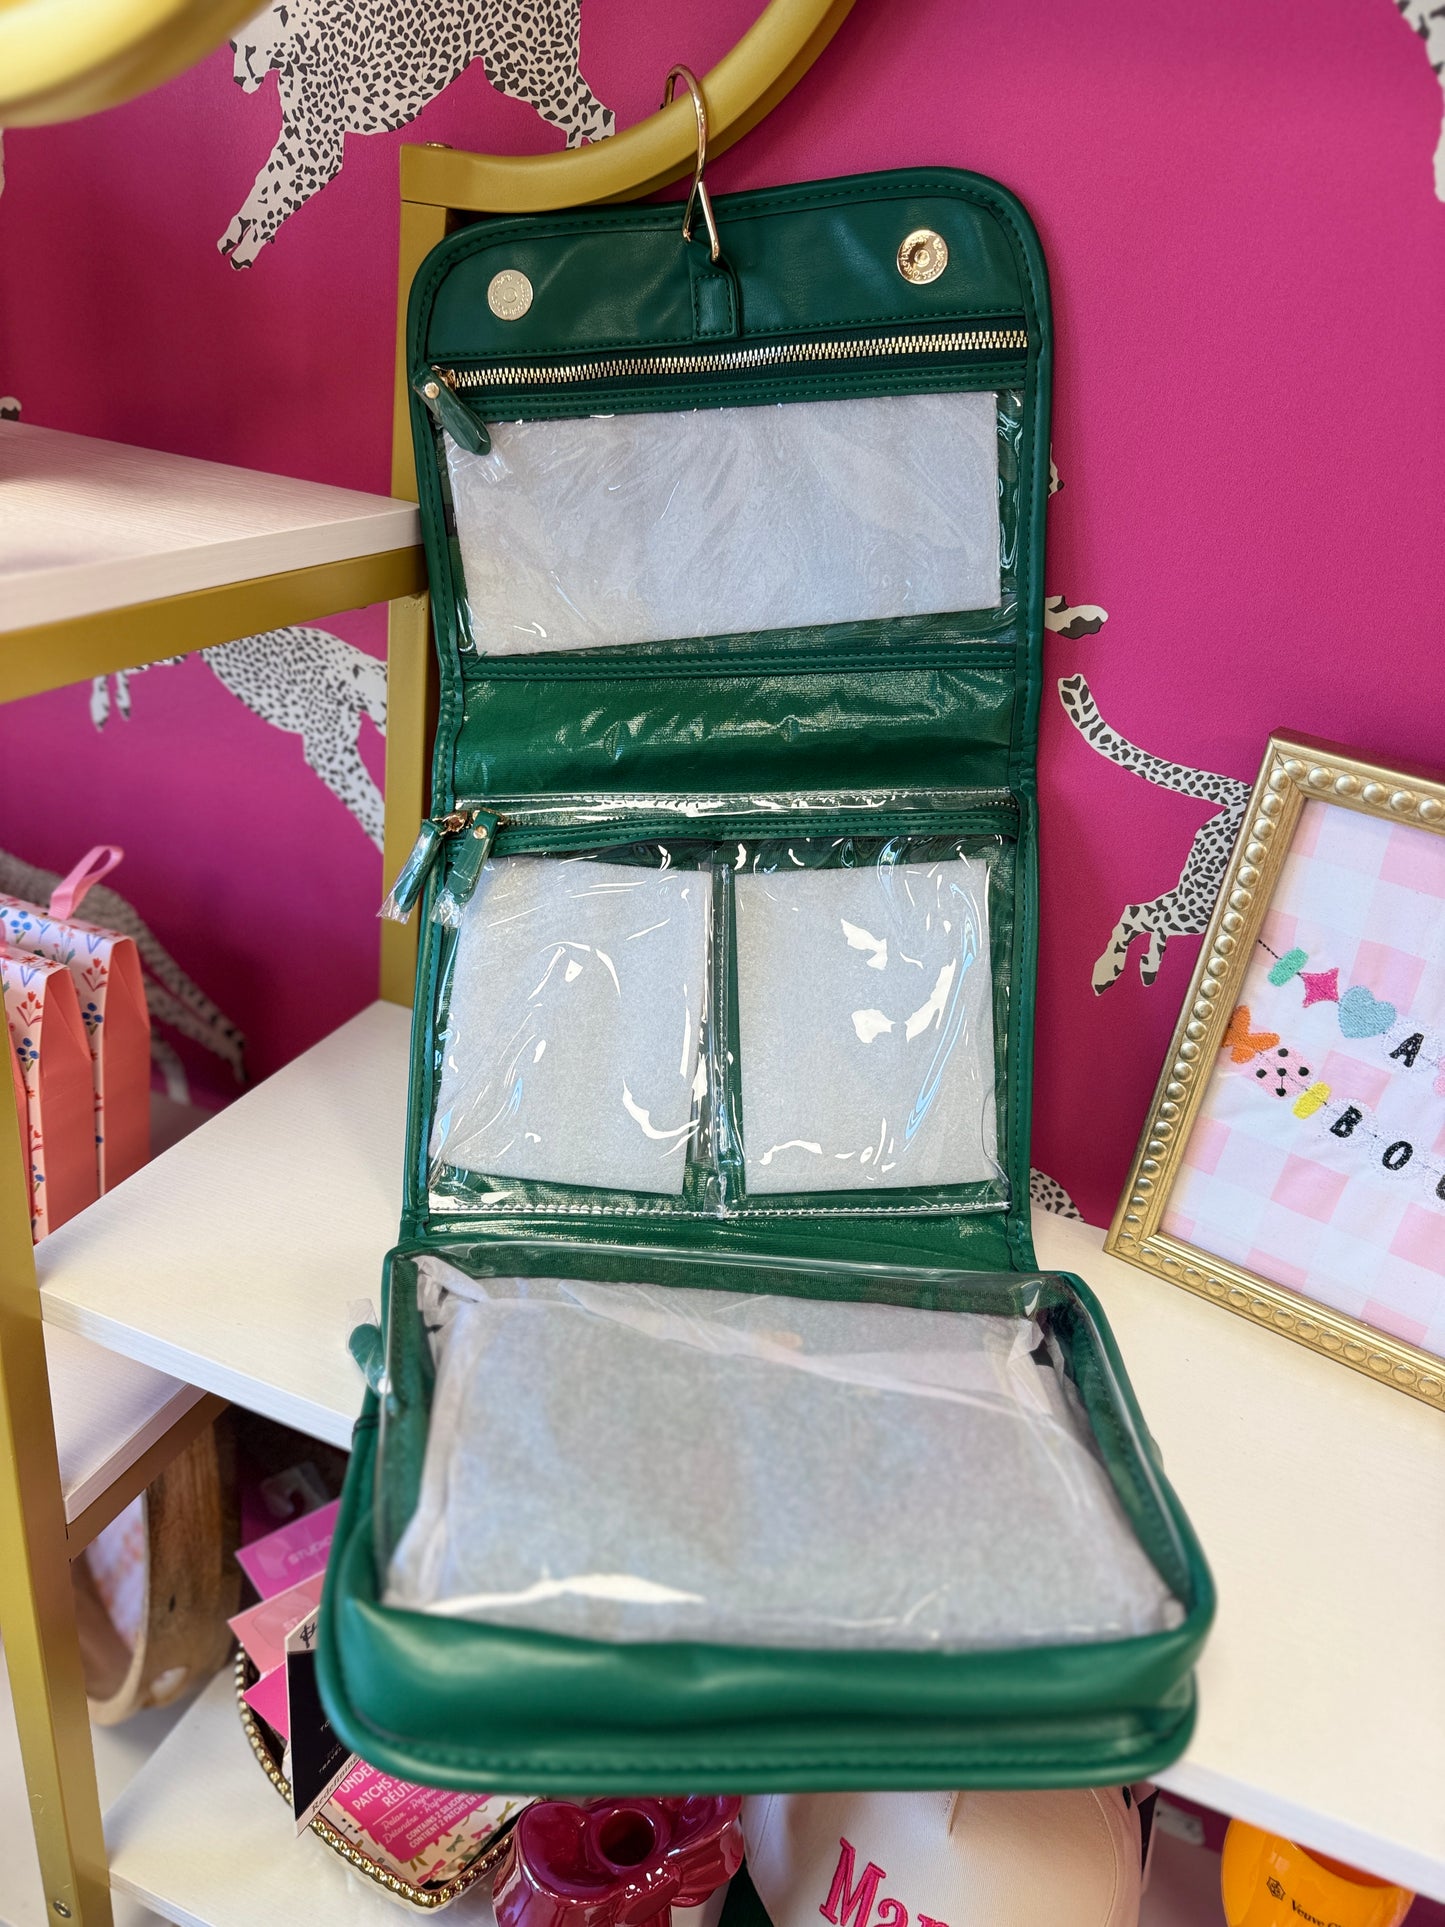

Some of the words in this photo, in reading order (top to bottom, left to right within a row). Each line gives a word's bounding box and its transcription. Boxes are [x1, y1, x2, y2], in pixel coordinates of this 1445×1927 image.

[1389, 1032, 1425, 1068] A
[352, 1777, 393, 1810] PATCHS
[382, 1780, 418, 1808] RÉUTI
[406, 1815, 437, 1841] CONTAINS
[409, 1823, 440, 1849] CONTIENT
[444, 1803, 468, 1824] PATCHS
[819, 1836, 950, 1927] Ma
[1291, 1898, 1326, 1927] Veuve
